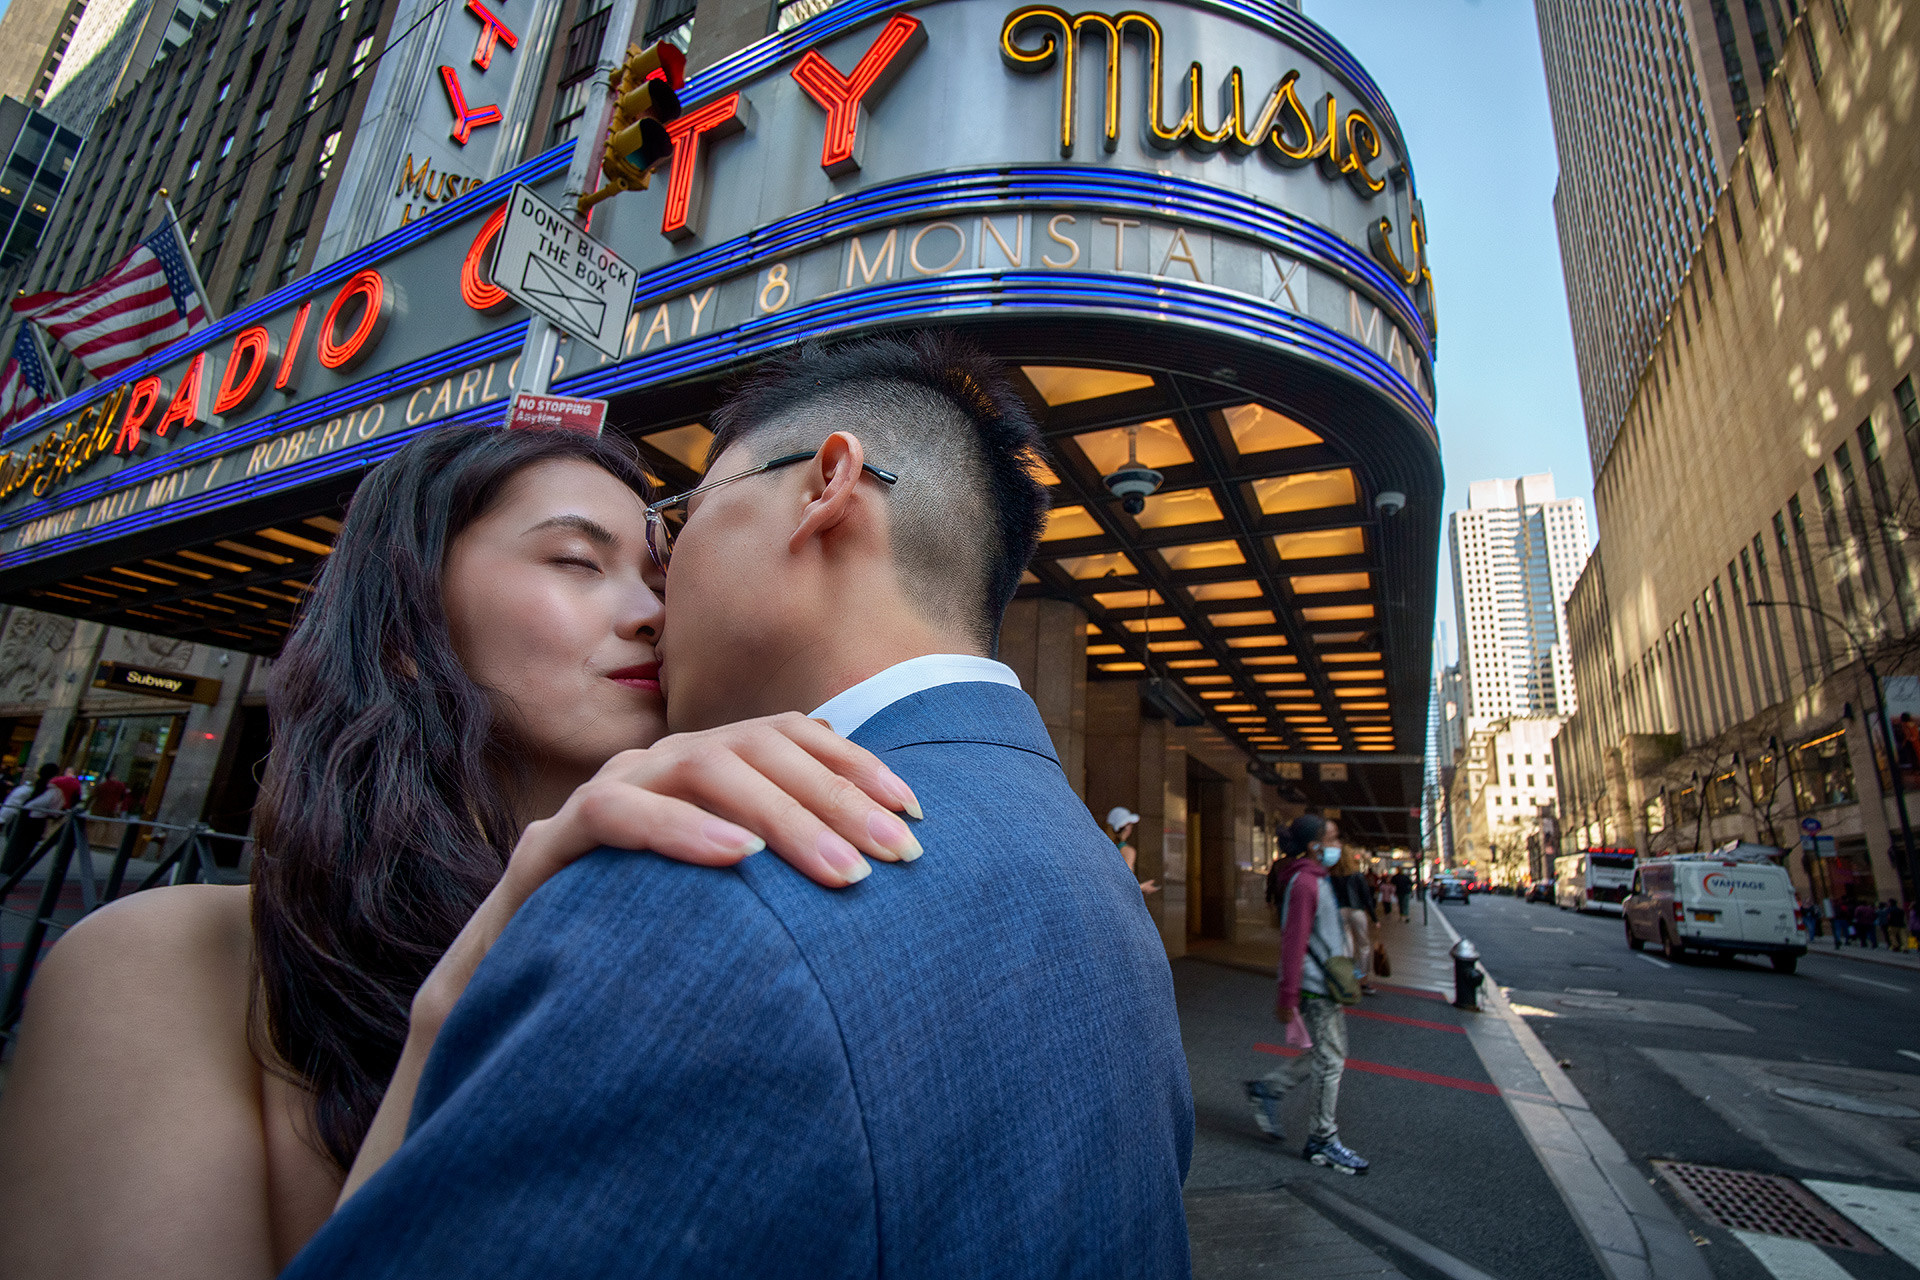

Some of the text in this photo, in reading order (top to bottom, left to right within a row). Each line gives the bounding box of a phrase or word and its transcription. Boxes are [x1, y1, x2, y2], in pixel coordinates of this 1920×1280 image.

[114, 4, 1386, 454] RADIO CTY Music
[521, 198, 629, 287] DON'T BLOCK
[539, 233, 608, 295] THE BOX
[145, 467, 195, 509] MAY
[204, 457, 222, 490] 7
[245, 403, 386, 476] ROBERTO
[759, 263, 791, 314] 8
[846, 214, 1204, 289] MONSTA
[1269, 251, 1301, 312] X
[518, 398, 592, 417] NO STOPPING
[126, 670, 183, 692] Subway
[1711, 879, 1765, 891] VANTAGE
